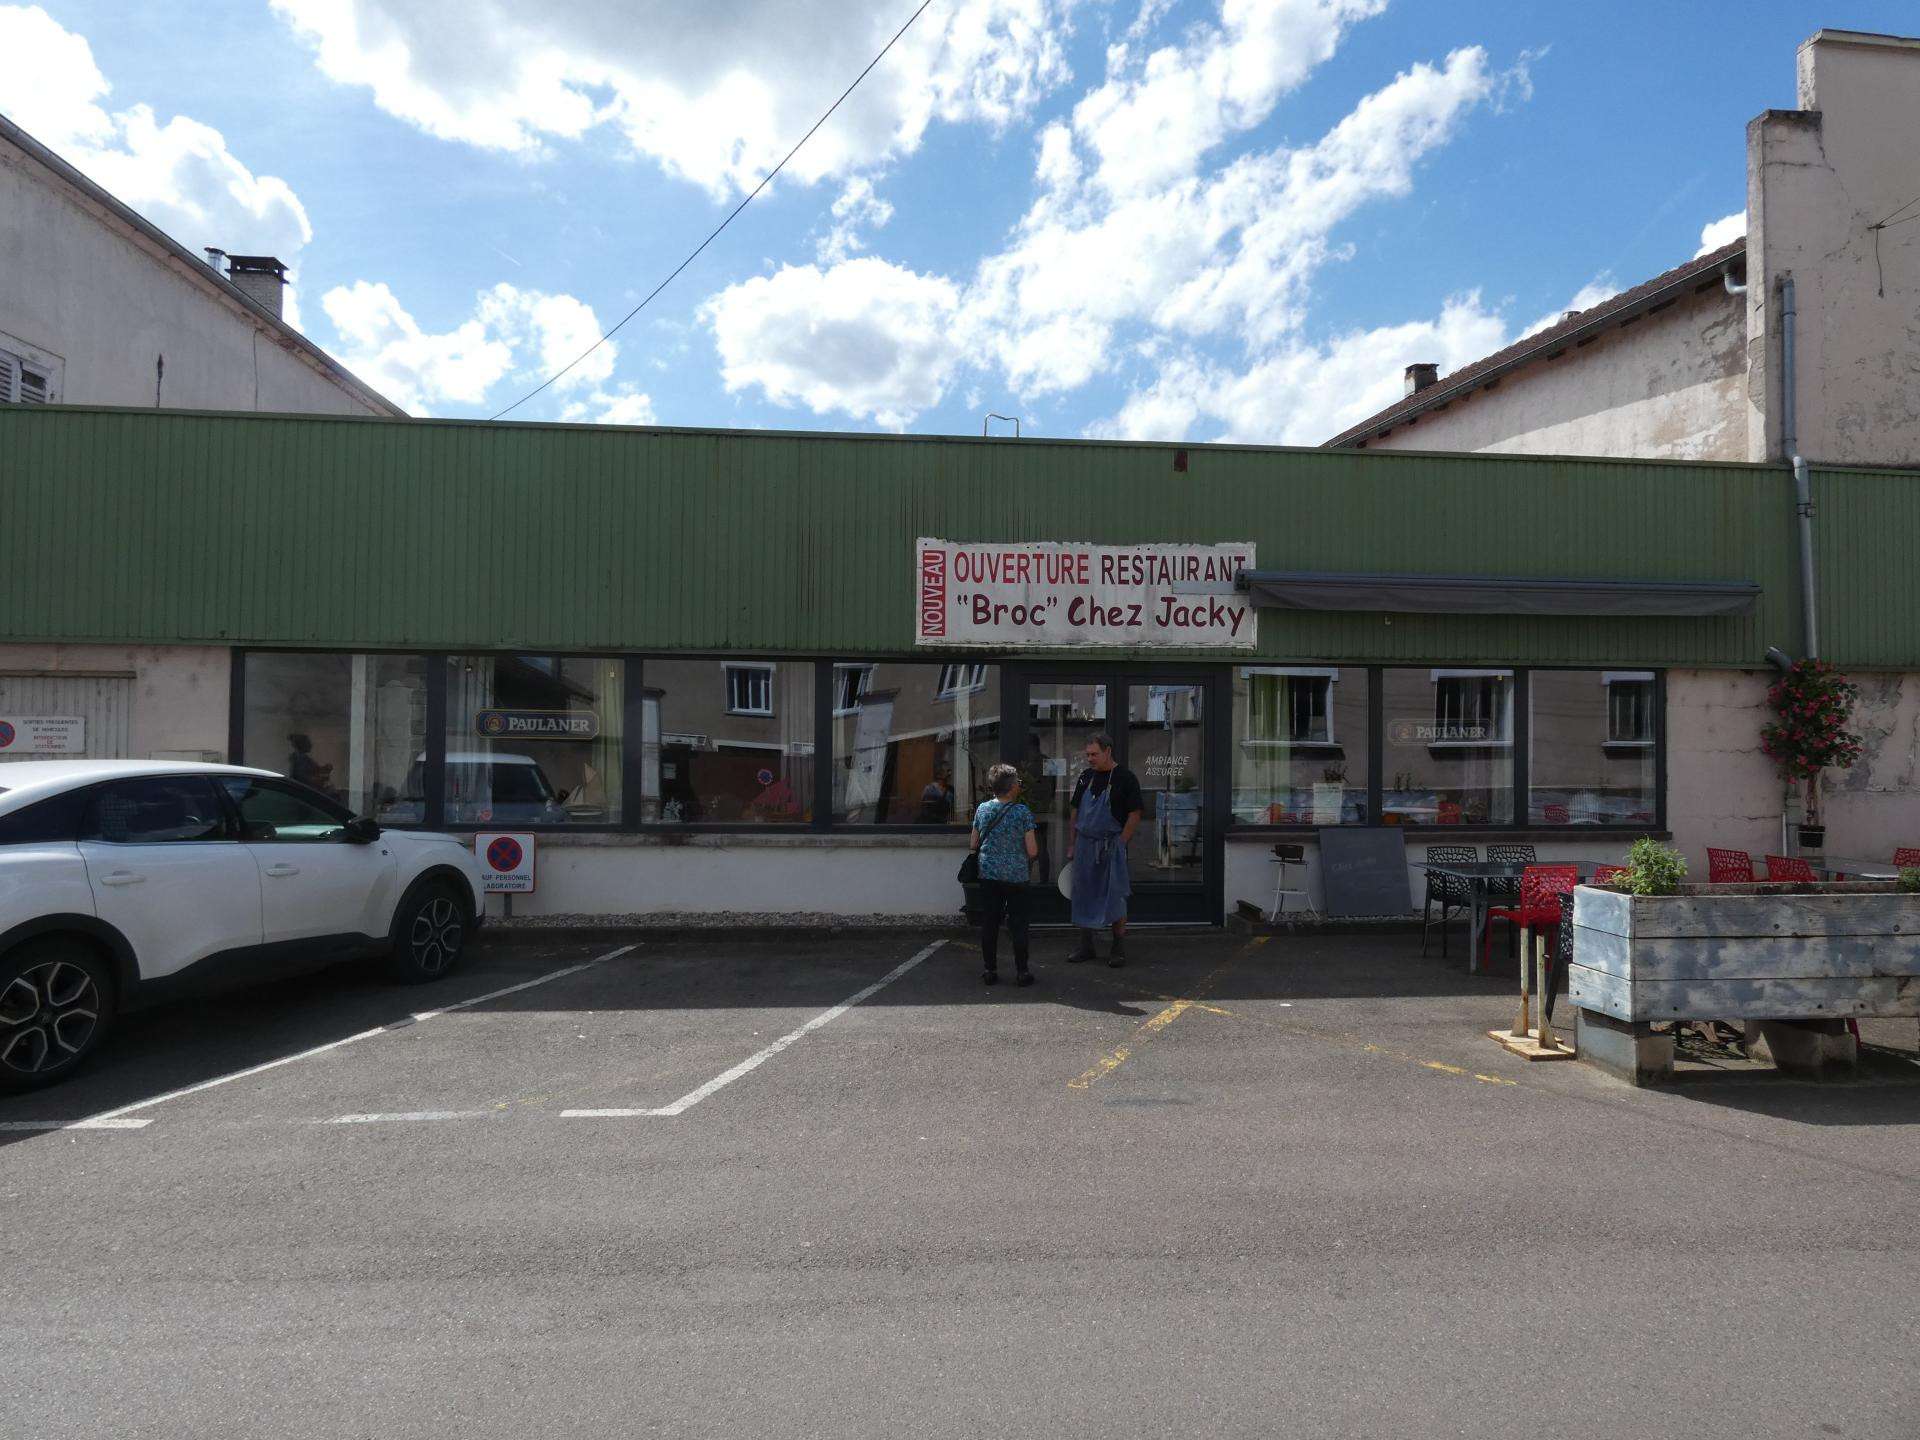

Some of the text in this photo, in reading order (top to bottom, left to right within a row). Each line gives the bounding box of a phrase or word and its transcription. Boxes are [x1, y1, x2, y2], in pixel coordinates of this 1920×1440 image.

[954, 552, 1246, 585] OUVERTURE RESTAURANT
[923, 551, 945, 635] NOUVEAU
[1067, 596, 1143, 626] Chez
[1155, 597, 1246, 636] Jacky
[508, 717, 591, 731] PAULANER
[1416, 726, 1486, 739] PAULANER
[1145, 755, 1191, 766] AMBIANCE
